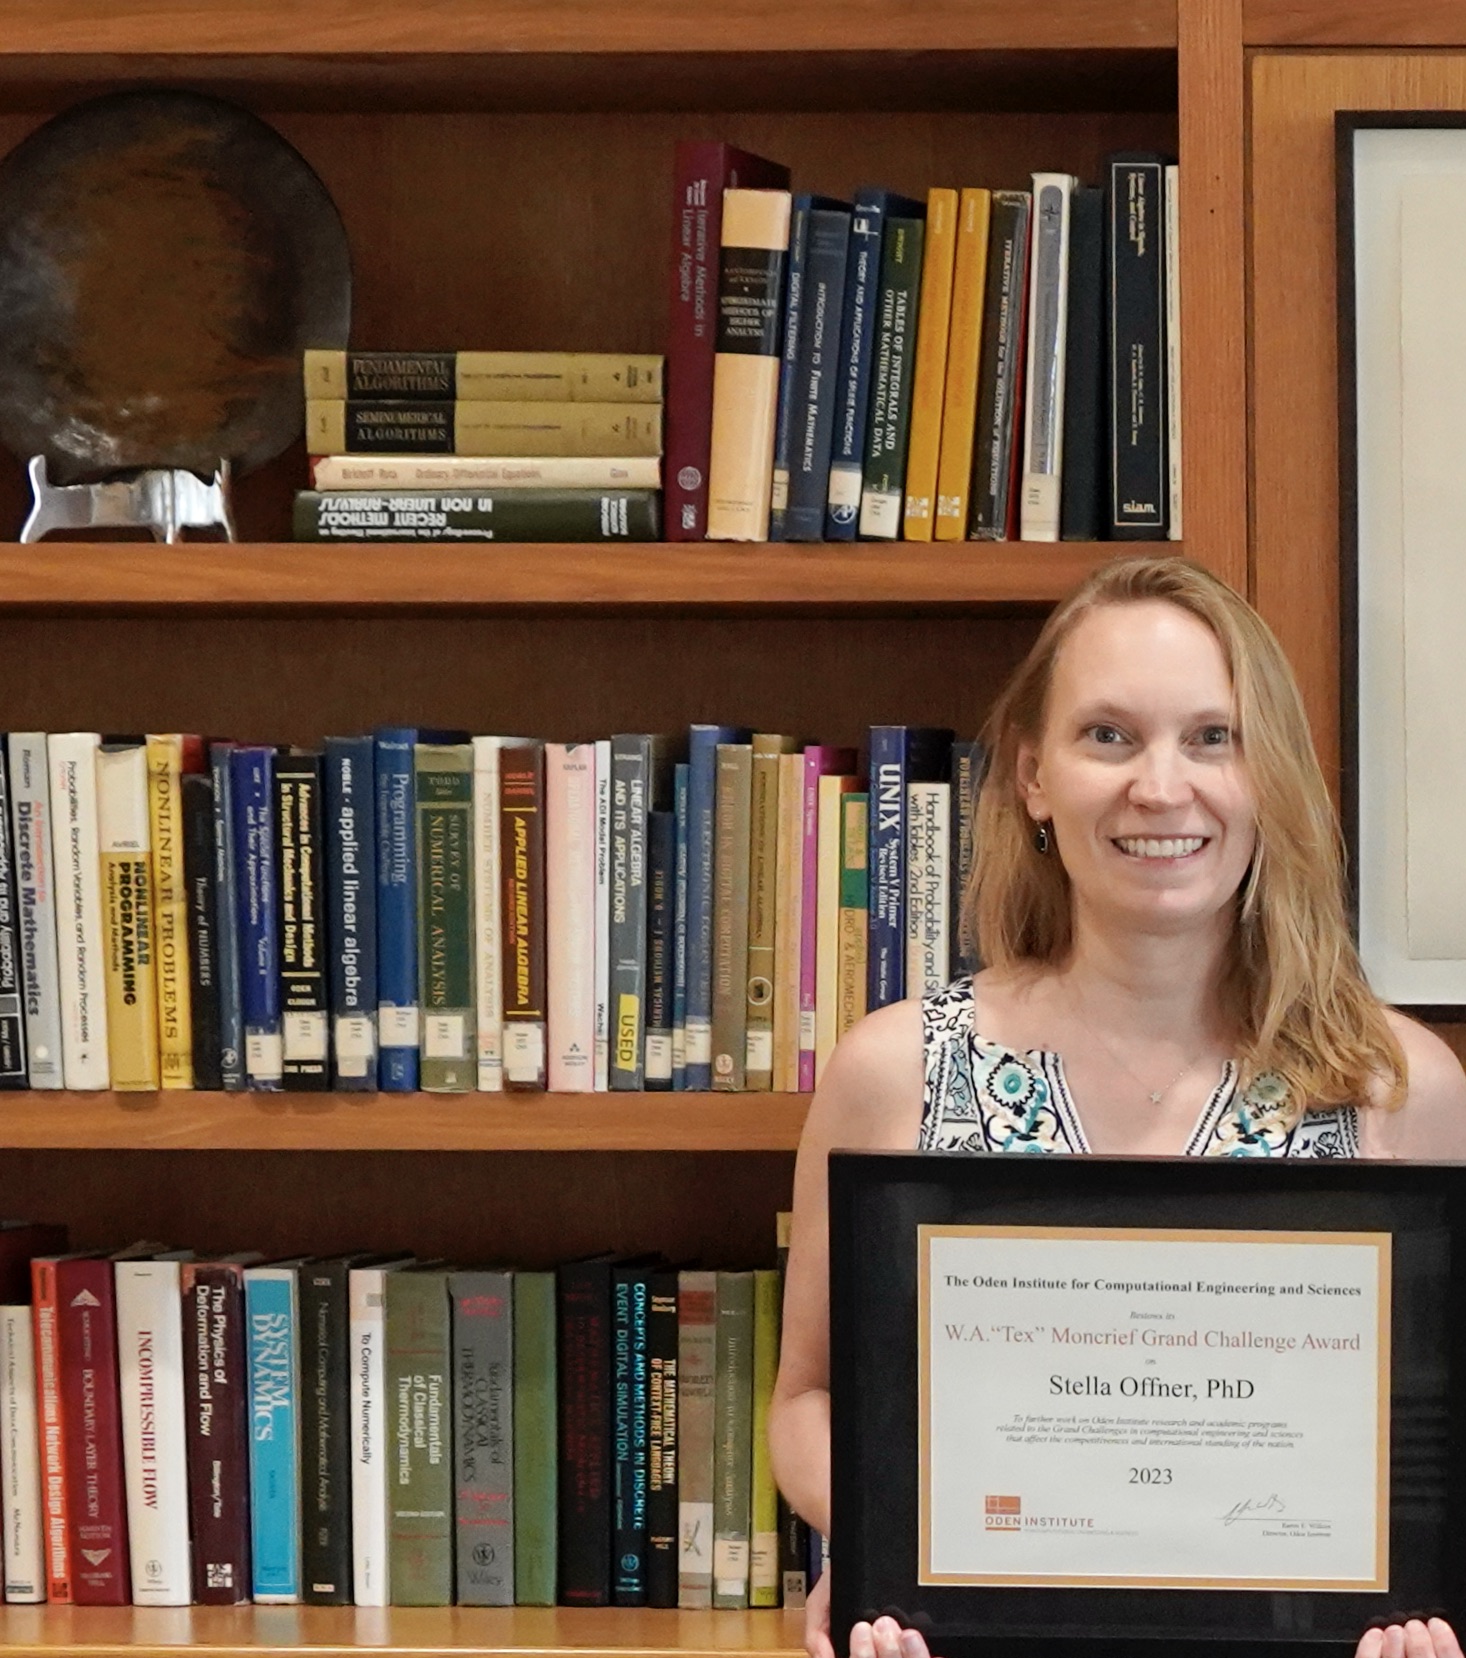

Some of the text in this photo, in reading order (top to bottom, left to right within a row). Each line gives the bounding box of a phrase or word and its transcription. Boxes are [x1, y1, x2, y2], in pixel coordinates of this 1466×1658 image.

[871, 288, 894, 457] OTHER MATHEMATICAL DATA
[884, 290, 907, 450] TABLES OF INTEGRALS AND
[613, 779, 626, 922] AND ITS APPLICATIONS
[630, 779, 642, 886] LINEAR ALGEBRA
[878, 764, 900, 833] UNIX
[17, 801, 40, 1015] Discrete Mathematics
[119, 861, 136, 1004] PROGRAMMING
[133, 861, 150, 964] NONLINEAR
[155, 762, 177, 1038] NONLINEAR PROBLEMS
[339, 757, 359, 1006] NOBLE applied linear algebra
[618, 1014, 634, 1062] USED
[212, 1286, 227, 1384] The Physics of
[945, 1274, 1361, 1296] The Oden Institute for Computational Engineering and Sciences
[196, 1285, 212, 1436] Deformation and Flow
[1049, 1374, 1254, 1398] Stella Offner, PhD
[1051, 1326, 1138, 1345] Moncrief
[1140, 1328, 1197, 1347] Grand
[1203, 1330, 1296, 1352] Challenge
[1301, 1332, 1360, 1350] Award
[138, 1330, 157, 1509] INCOMPRESSIBLE FLOW
[360, 1332, 372, 1464] To Compute Numerically
[398, 1376, 411, 1484] Thermodynamics
[413, 1374, 427, 1448] of Classical
[428, 1374, 442, 1464] Fundamentals
[984, 1515, 1093, 1528] ODEN INSTITUTE
[1128, 1466, 1172, 1484] 2023
